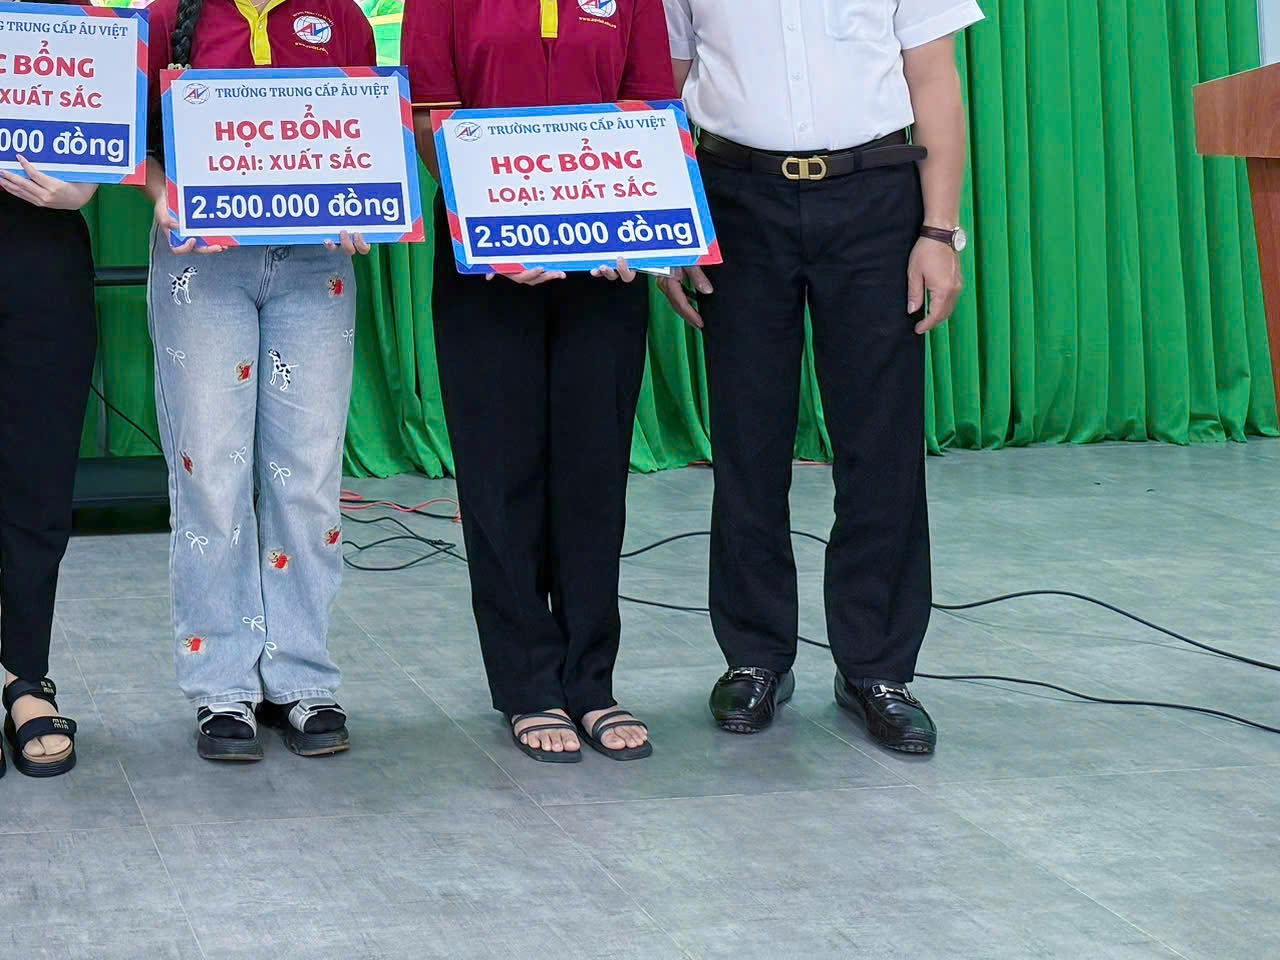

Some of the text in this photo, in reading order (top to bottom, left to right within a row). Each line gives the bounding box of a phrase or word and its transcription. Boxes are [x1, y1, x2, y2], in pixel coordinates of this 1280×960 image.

[6, 21, 50, 33] TRUNG
[53, 19, 77, 34] CẤP
[79, 22, 96, 35] ÂU
[99, 24, 128, 39] VIỆT
[13, 40, 94, 78] BỔNG
[60, 84, 102, 108] SẮC
[215, 83, 389, 98] TRƯỜNG TRUNG CẤP ÂU VIỆT
[215, 104, 361, 148] HỌC BỔNG
[488, 115, 667, 136] TRƯỜNG TRUNG CẤP ÂU VIỆT
[52, 127, 124, 161] đồng
[490, 138, 643, 180] HỌC BỔNG
[208, 146, 372, 175] LOẠI: XUẤT SẮC
[191, 187, 399, 221] 2.500.000 đồng
[488, 176, 658, 206] LOẠI: XUẤT SẮC
[474, 214, 693, 248] 2.500.000 đồng
